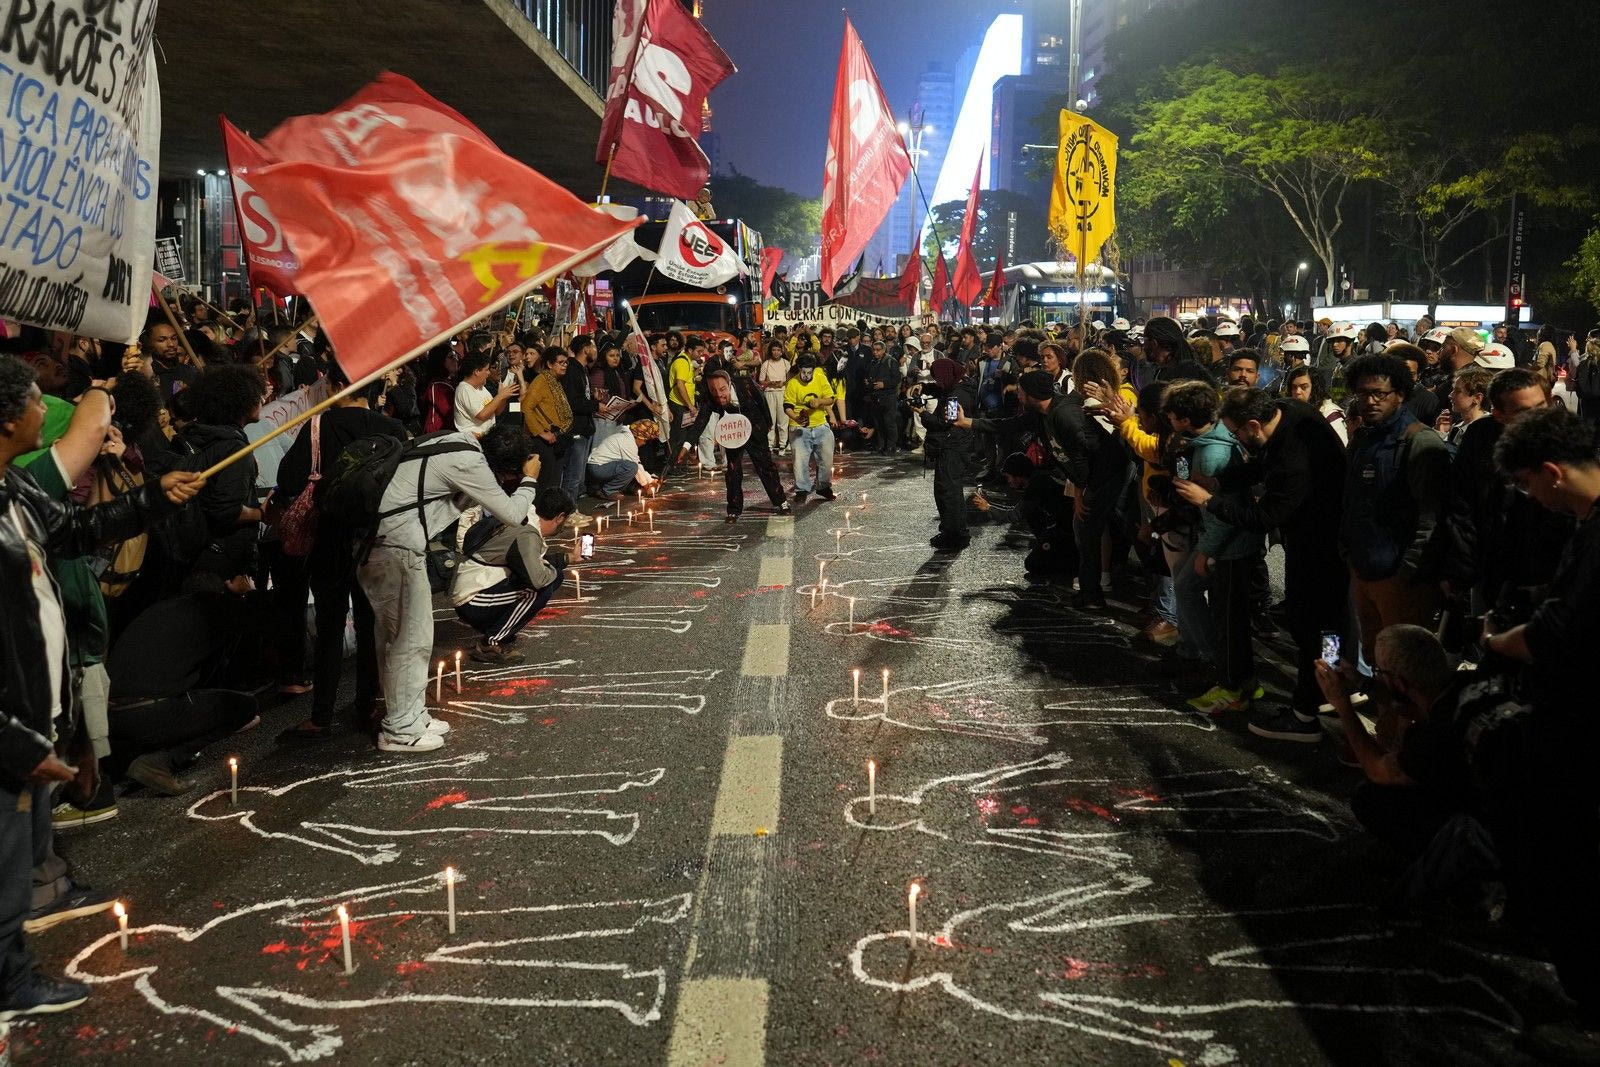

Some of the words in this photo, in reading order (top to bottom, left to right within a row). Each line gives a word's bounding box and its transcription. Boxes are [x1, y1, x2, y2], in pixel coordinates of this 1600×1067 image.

[0, 62, 58, 146] IÇA
[0, 192, 83, 269] TADO
[1515, 211, 1524, 242] Branca
[1007, 227, 1015, 258] Pamplona
[1513, 245, 1522, 267] Casa
[0, 262, 89, 332] VOLUCIONÁRIA
[767, 309, 780, 321] DE
[784, 306, 824, 321] GUERRA
[720, 430, 746, 442] MATA!
